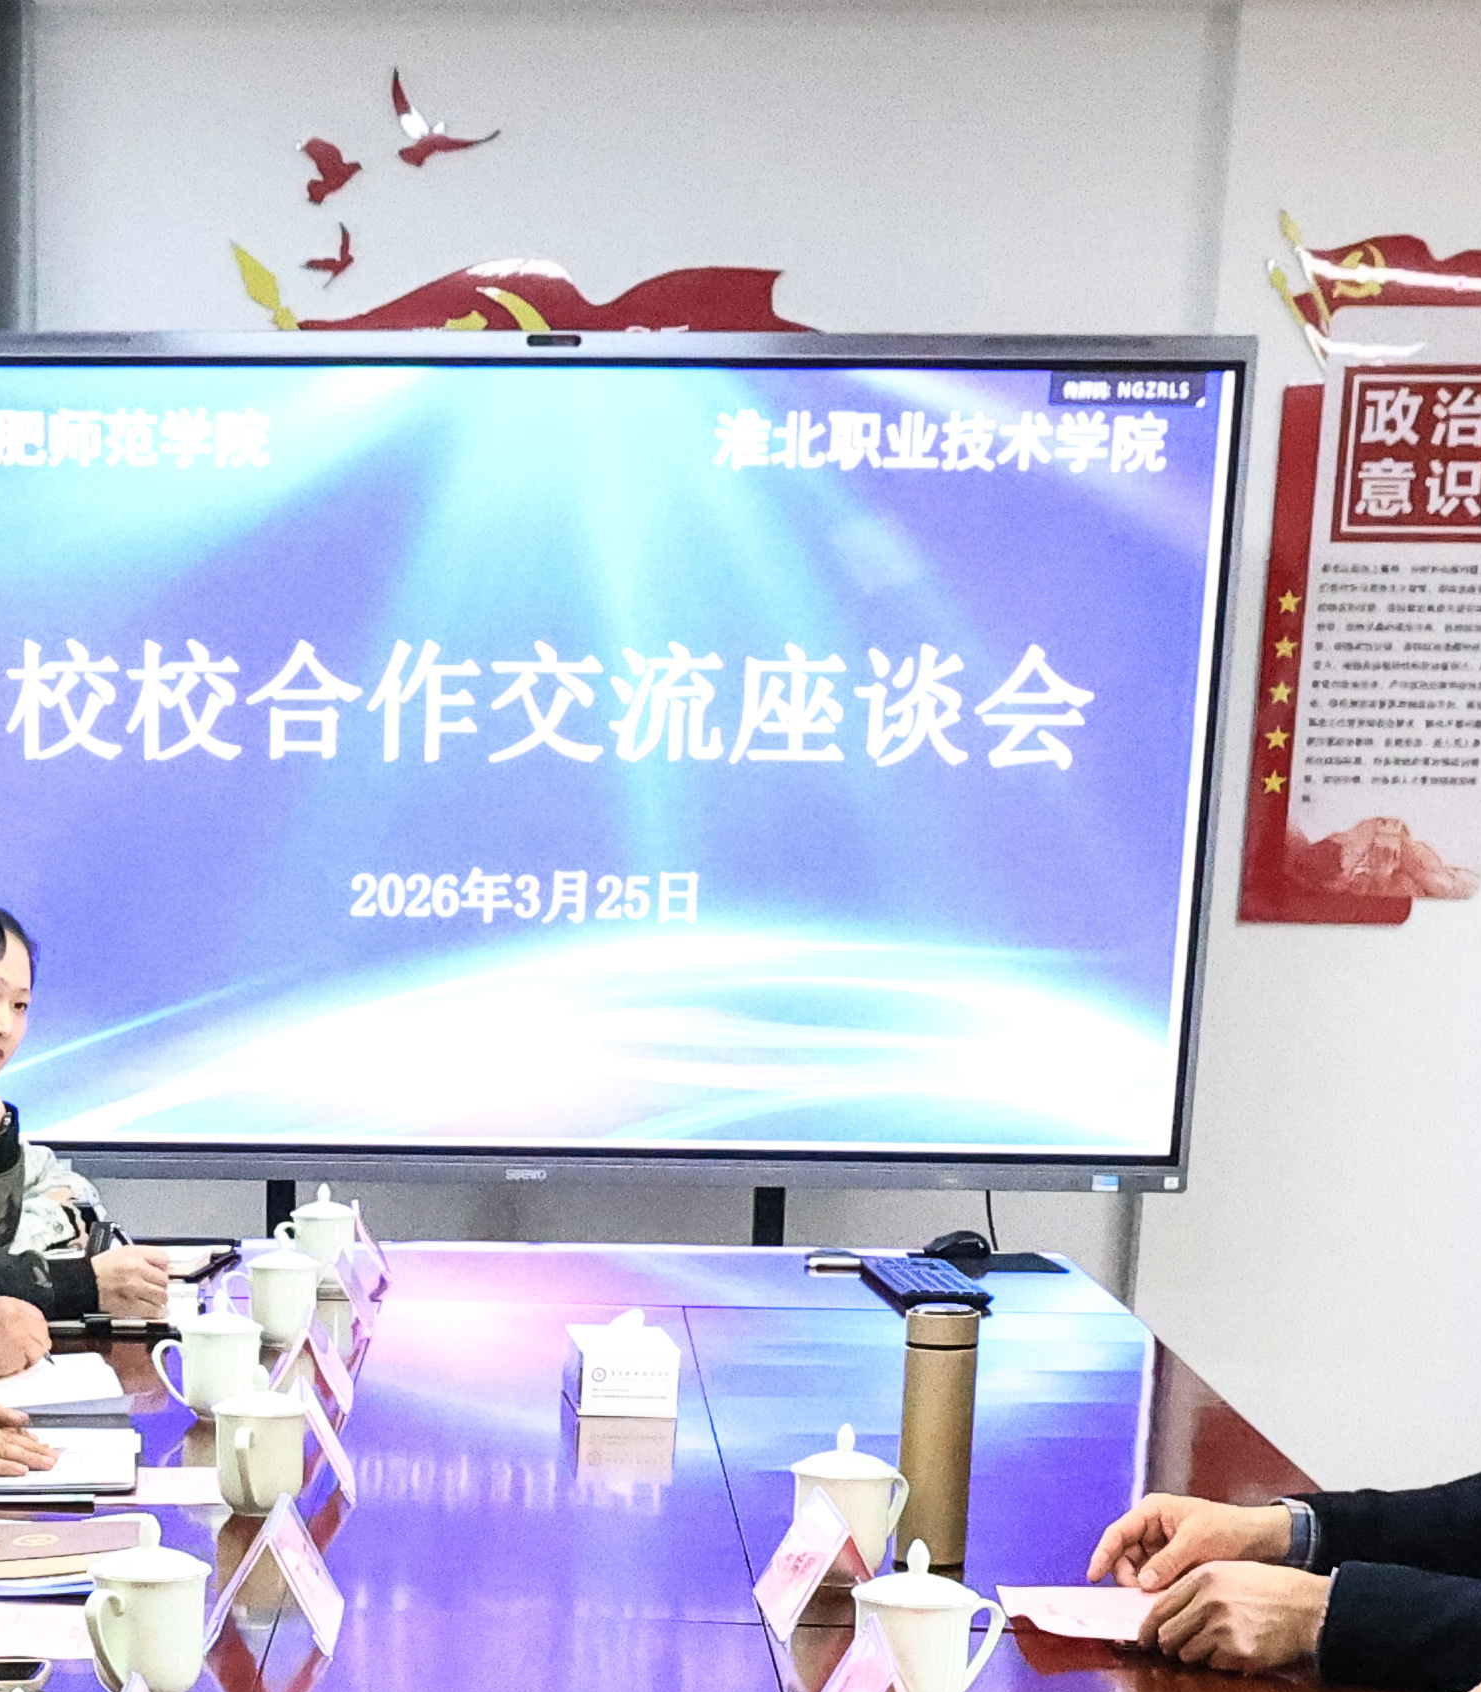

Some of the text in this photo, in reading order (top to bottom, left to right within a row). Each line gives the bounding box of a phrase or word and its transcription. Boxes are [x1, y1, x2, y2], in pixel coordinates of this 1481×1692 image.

[1117, 381, 1190, 400] NGZRLS
[712, 408, 1169, 473] 淮北职业技术学院
[5, 637, 1097, 771] 校校合作交流座谈会
[349, 865, 700, 924] 2026年3月25日
